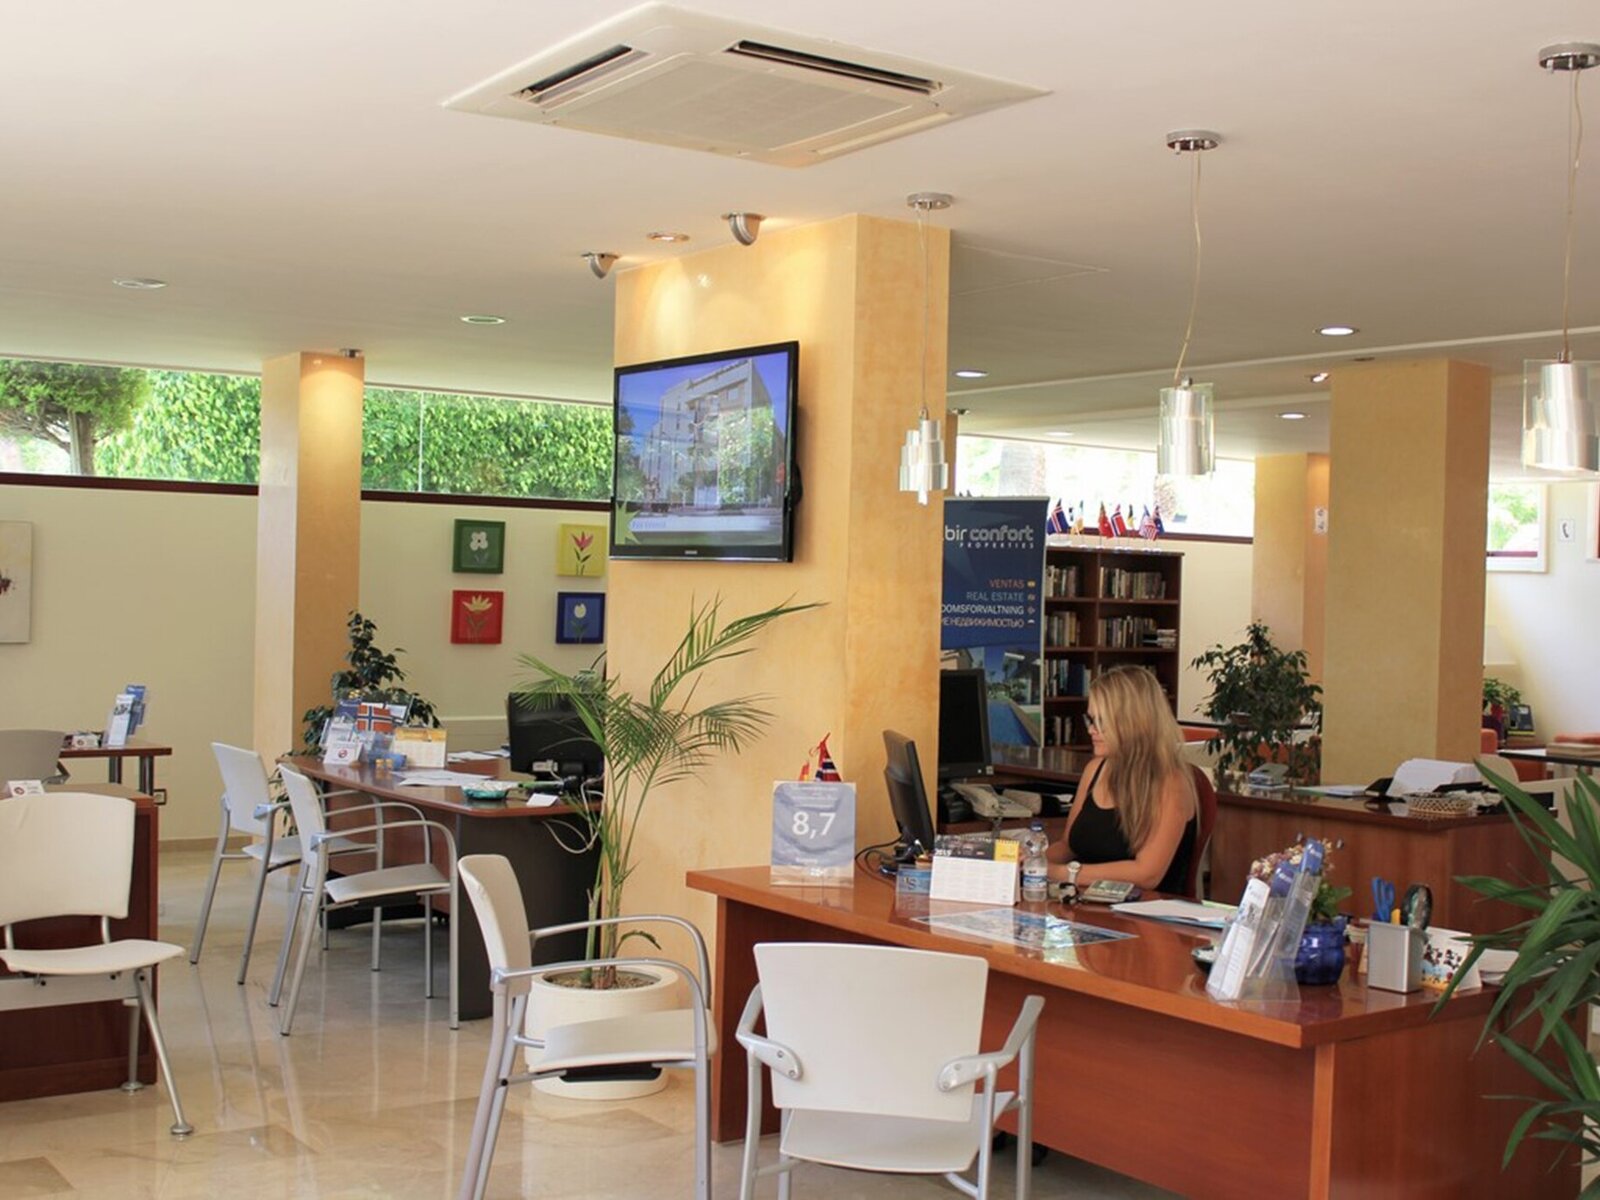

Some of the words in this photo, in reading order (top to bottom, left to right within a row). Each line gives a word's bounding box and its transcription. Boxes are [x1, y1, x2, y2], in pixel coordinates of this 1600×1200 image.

[970, 524, 1034, 541] confort
[990, 579, 1024, 588] VENTAS
[966, 591, 988, 601] REAL
[991, 592, 1024, 602] ESTATE
[792, 811, 836, 839] 8,7
